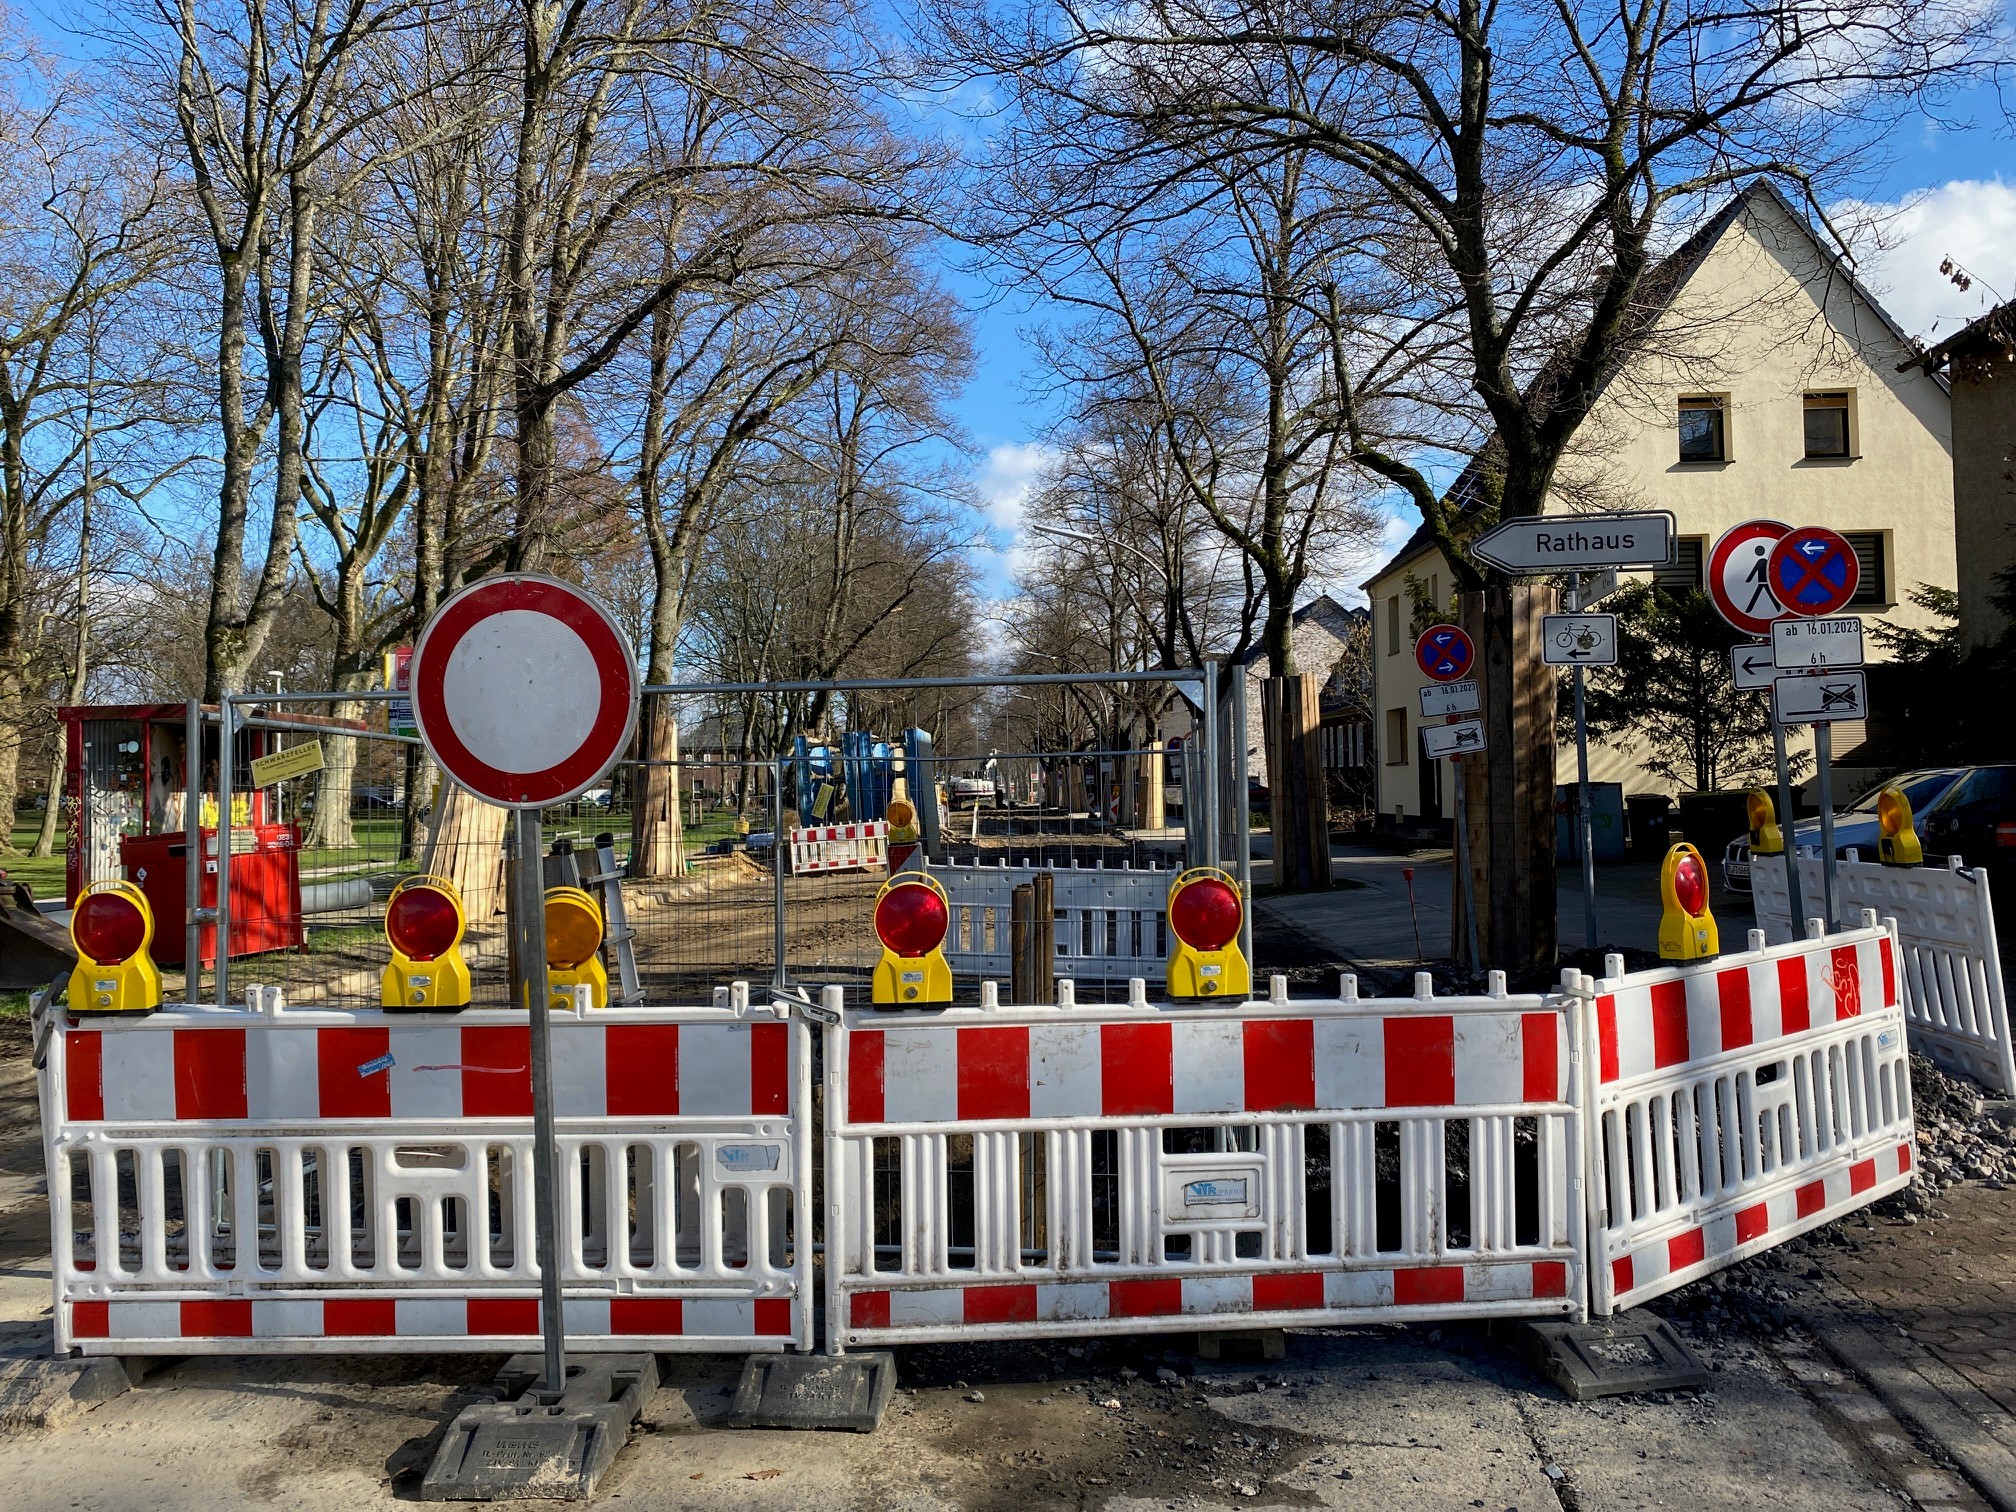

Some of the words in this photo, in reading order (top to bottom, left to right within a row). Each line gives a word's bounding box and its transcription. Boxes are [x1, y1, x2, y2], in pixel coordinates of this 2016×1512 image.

[1536, 531, 1635, 553] Rathaus
[1785, 624, 1798, 636] ab
[1806, 620, 1859, 635] 16.01.2023
[1810, 652, 1817, 664] 6
[1819, 651, 1826, 664] h
[1423, 689, 1432, 698] ab
[1441, 682, 1476, 695] 16.01.2023
[1446, 703, 1451, 712] 6
[1451, 703, 1457, 712] h
[255, 743, 317, 768] SCHWARZFELLER
